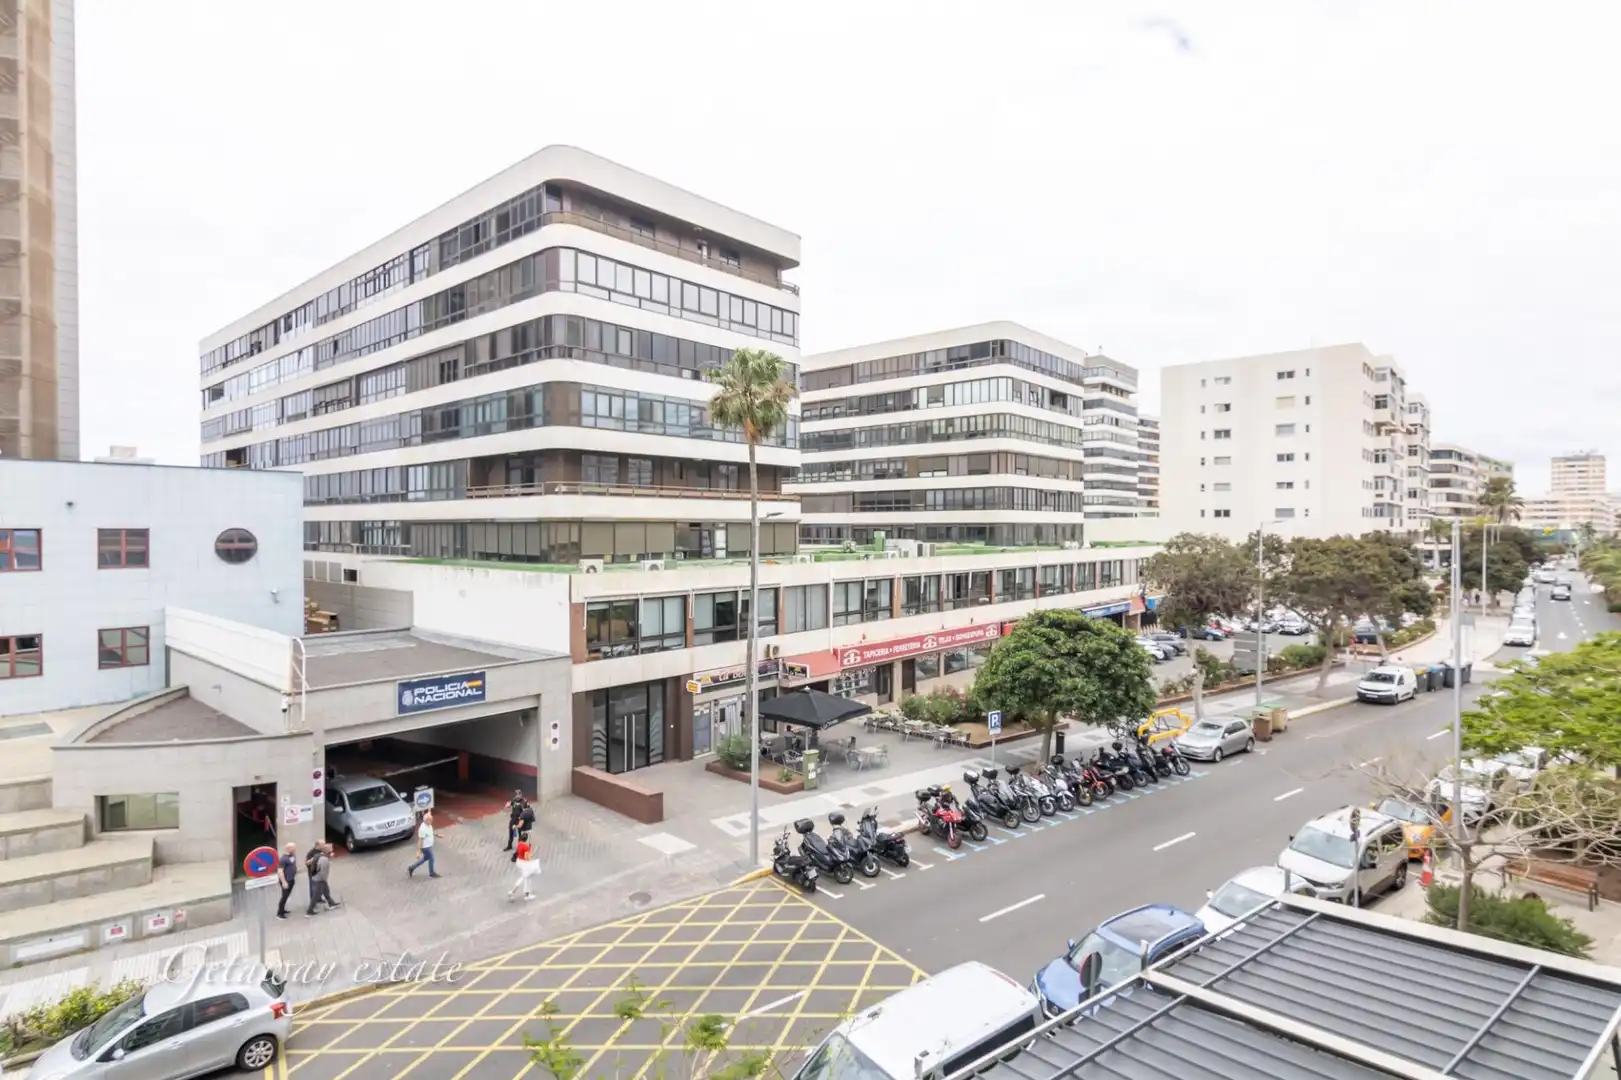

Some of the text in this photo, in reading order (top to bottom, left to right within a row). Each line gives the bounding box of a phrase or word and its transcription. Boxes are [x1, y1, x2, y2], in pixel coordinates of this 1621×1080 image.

[414, 681, 469, 696] POLICIA
[414, 688, 483, 705] NACIONAL
[991, 714, 999, 727] P
